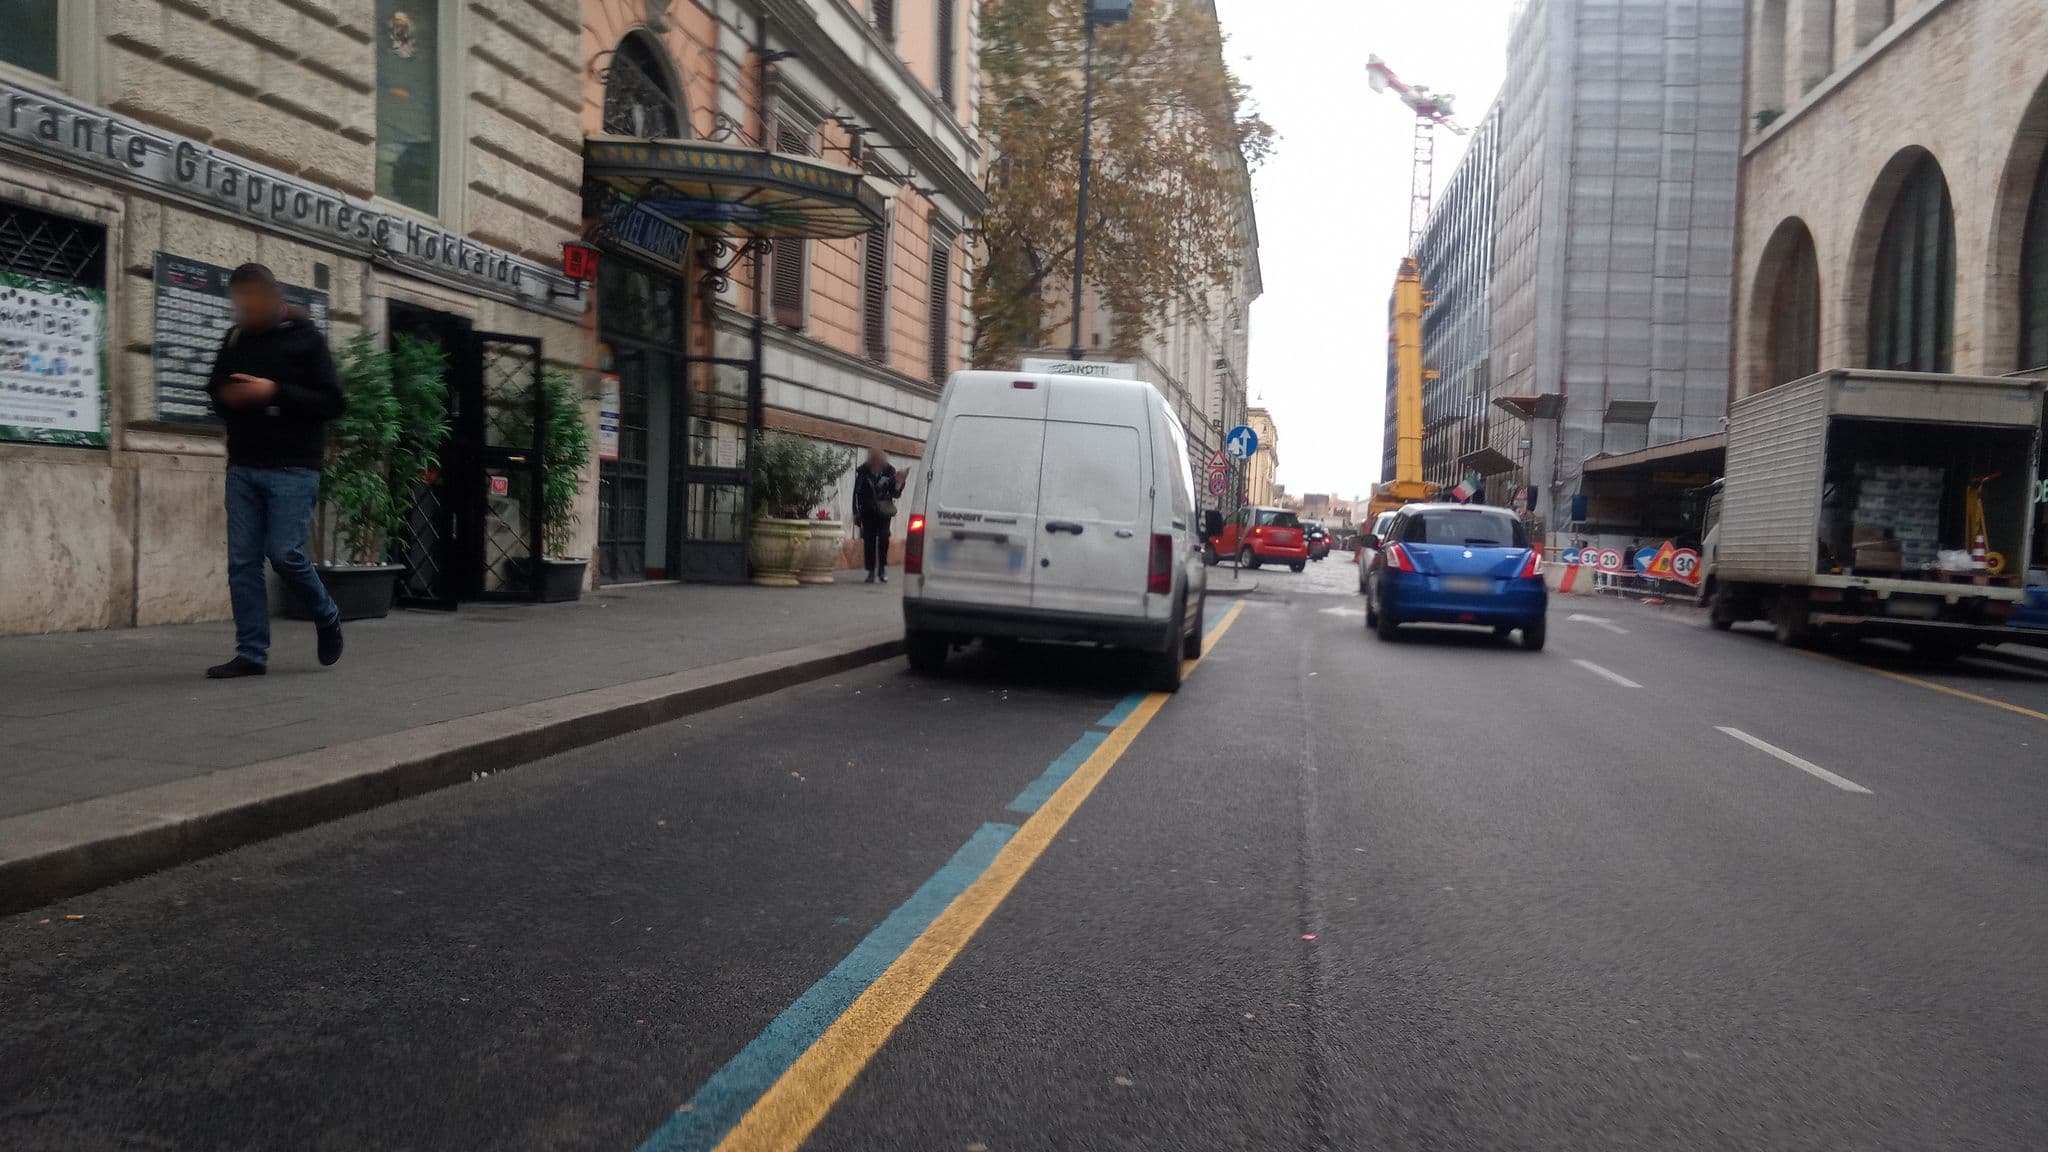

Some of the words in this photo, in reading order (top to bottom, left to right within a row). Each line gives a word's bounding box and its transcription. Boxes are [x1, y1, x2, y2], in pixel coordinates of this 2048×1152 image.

[9, 93, 147, 168] rante
[175, 140, 390, 244] Giapponese
[406, 220, 521, 286] Hokkaido
[937, 510, 983, 522] TRANSIT
[1602, 554, 1617, 566] 20
[1675, 557, 1696, 572] 30
